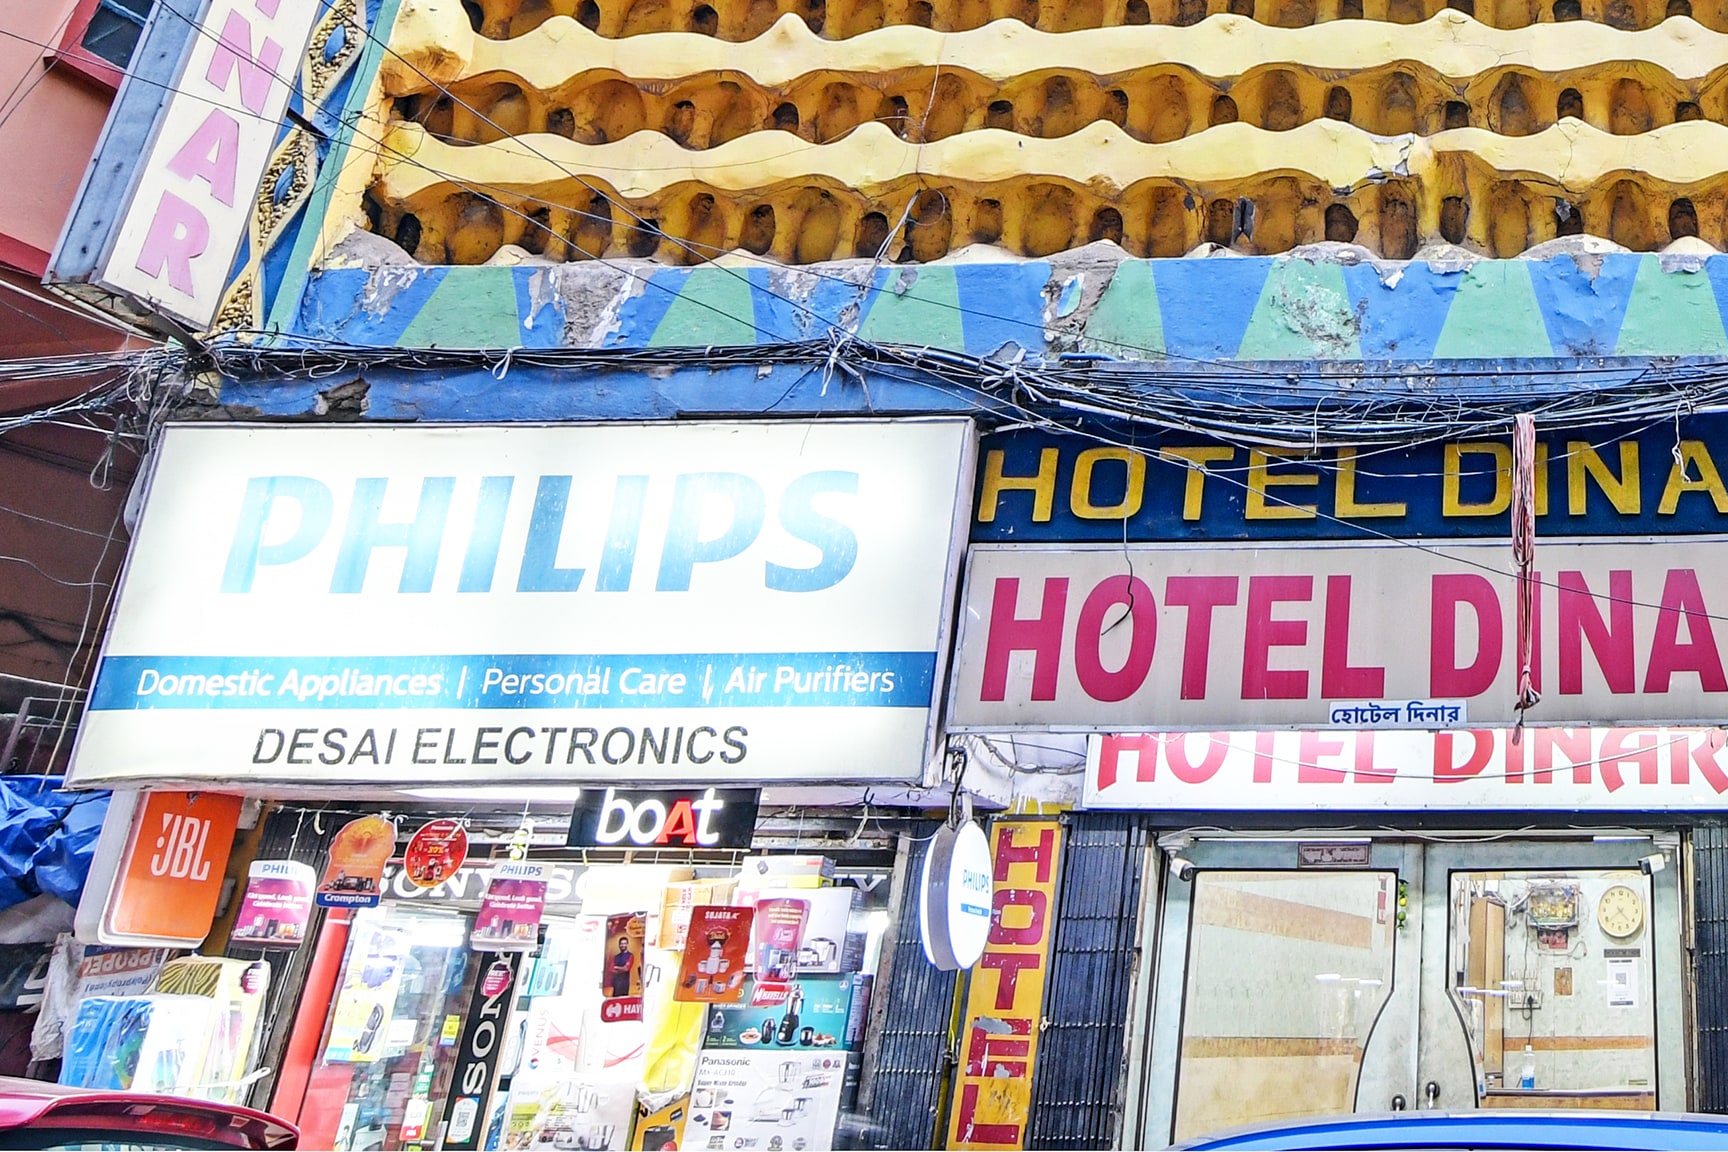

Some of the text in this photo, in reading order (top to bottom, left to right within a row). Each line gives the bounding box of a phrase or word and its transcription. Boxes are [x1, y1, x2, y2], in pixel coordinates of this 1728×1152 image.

[978, 446, 1406, 523] HOTEL
[220, 470, 859, 593] PHILIPS
[980, 575, 1386, 703] HOTEL
[136, 668, 273, 697] Domestic
[277, 668, 442, 702] Appliances
[483, 667, 610, 696] Personal
[619, 666, 687, 695] Care
[724, 666, 768, 694] Air
[774, 664, 896, 695] Purifiers
[1331, 700, 1462, 724] হোটেল দিনার
[252, 725, 749, 766] DESAI ELECTRONICS
[1097, 730, 1398, 792] HOTEL
[150, 814, 212, 881] JBL
[500, 864, 543, 876] PHILIPS
[963, 869, 990, 895] PHILIPS
[324, 893, 372, 905] Crompton
[956, 827, 1055, 1145] HOTEL
[701, 1056, 751, 1066] Panasonic
